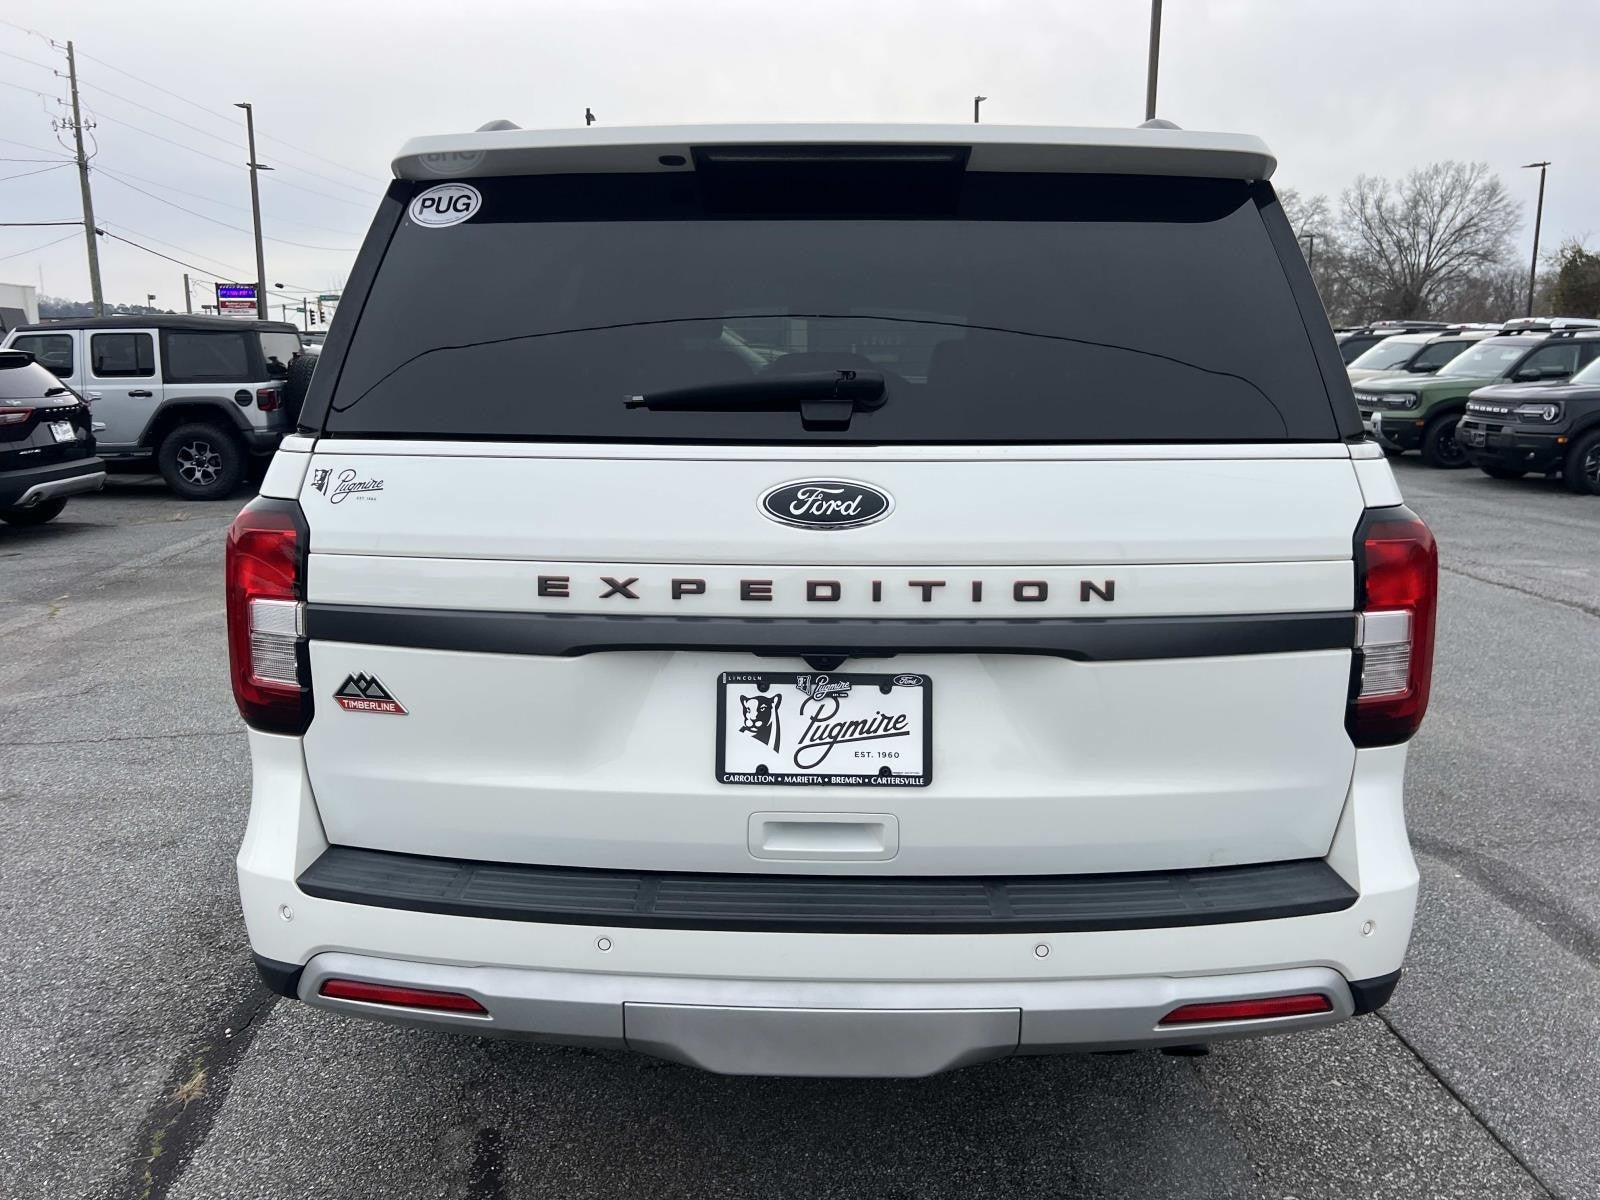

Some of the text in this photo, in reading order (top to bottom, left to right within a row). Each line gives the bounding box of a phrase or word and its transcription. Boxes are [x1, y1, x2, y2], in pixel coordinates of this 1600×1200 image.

[419, 194, 472, 215] PUG
[331, 468, 384, 504] Pugmire
[789, 487, 862, 516] Ford
[537, 575, 1115, 602] EXPEDITION
[813, 674, 851, 700] Pugmire
[342, 699, 396, 711] TIMBERLINE
[793, 696, 910, 769] Pugmire
[854, 751, 900, 759] EST. 1960
[723, 774, 925, 785] CARROLLTON MARIETTA BREMEN CARTERSVILLE
